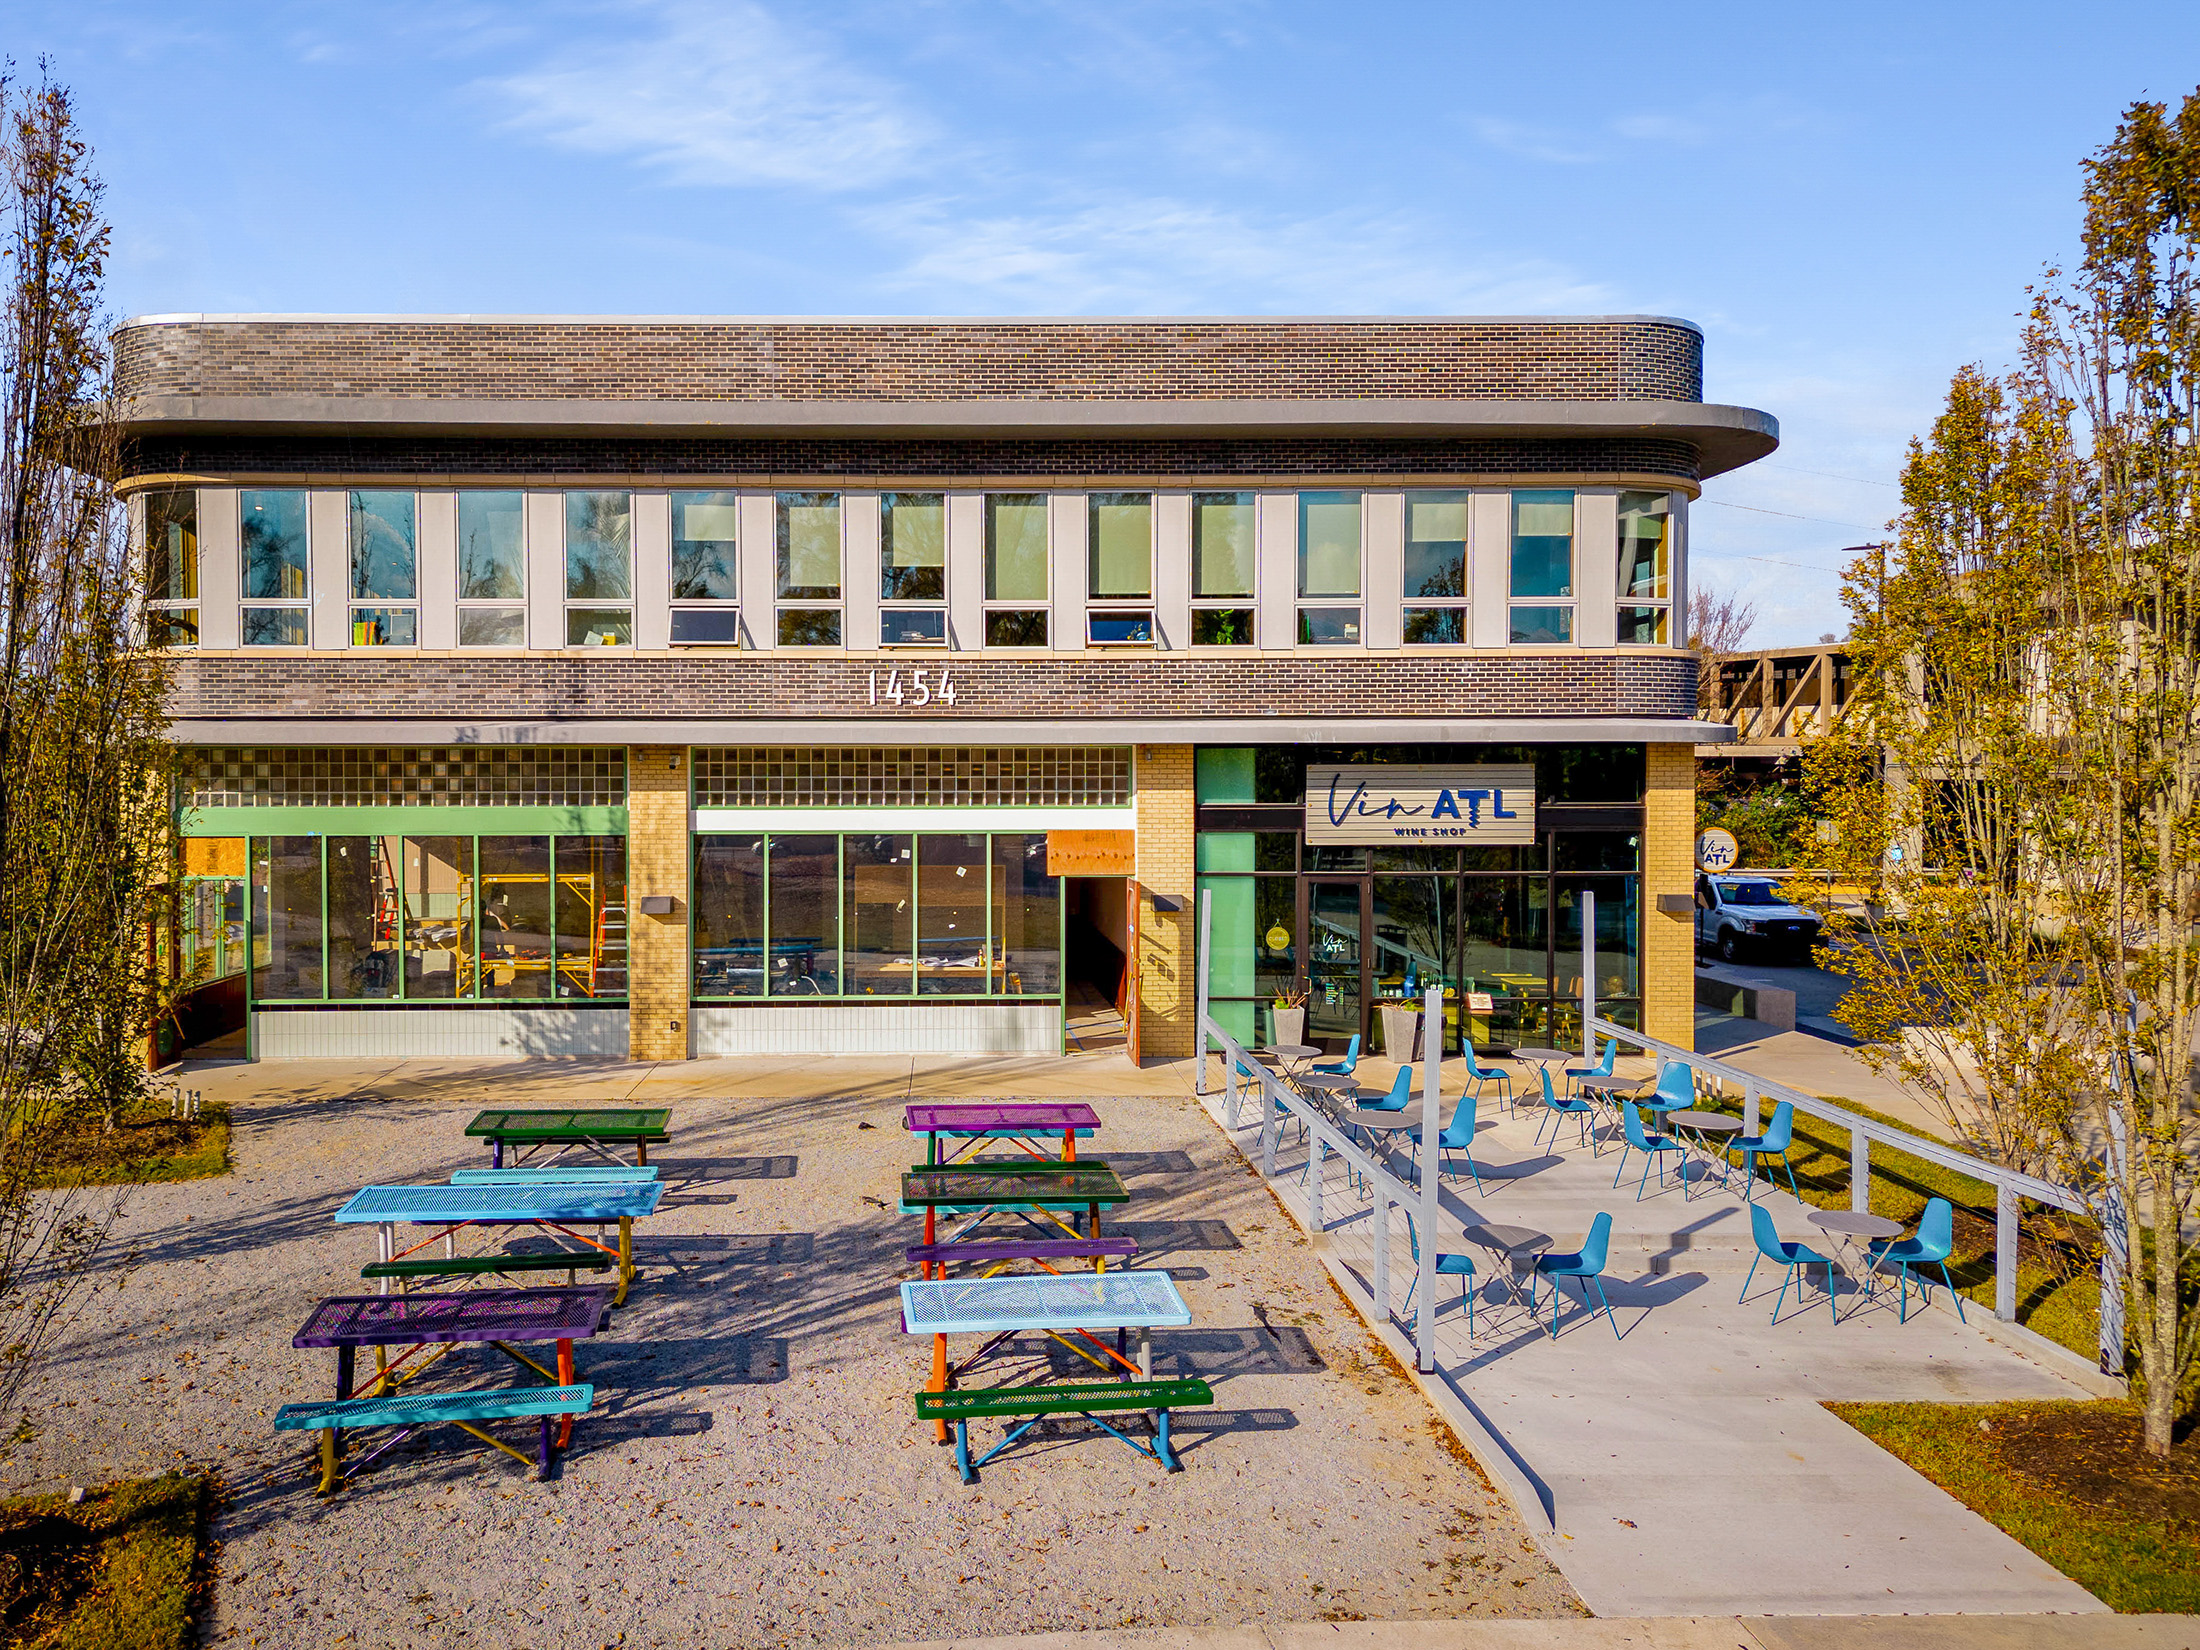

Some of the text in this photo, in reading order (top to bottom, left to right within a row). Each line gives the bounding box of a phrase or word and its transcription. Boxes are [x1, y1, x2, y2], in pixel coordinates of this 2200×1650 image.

[869, 670, 957, 706] 1454
[1328, 773, 1517, 829] Vin ATL
[1394, 828, 1467, 837] WINE SHOP
[1700, 836, 1734, 855] Vin
[1704, 854, 1730, 865] ATL
[1322, 932, 1348, 946] Vin
[1326, 944, 1345, 953] ATL
